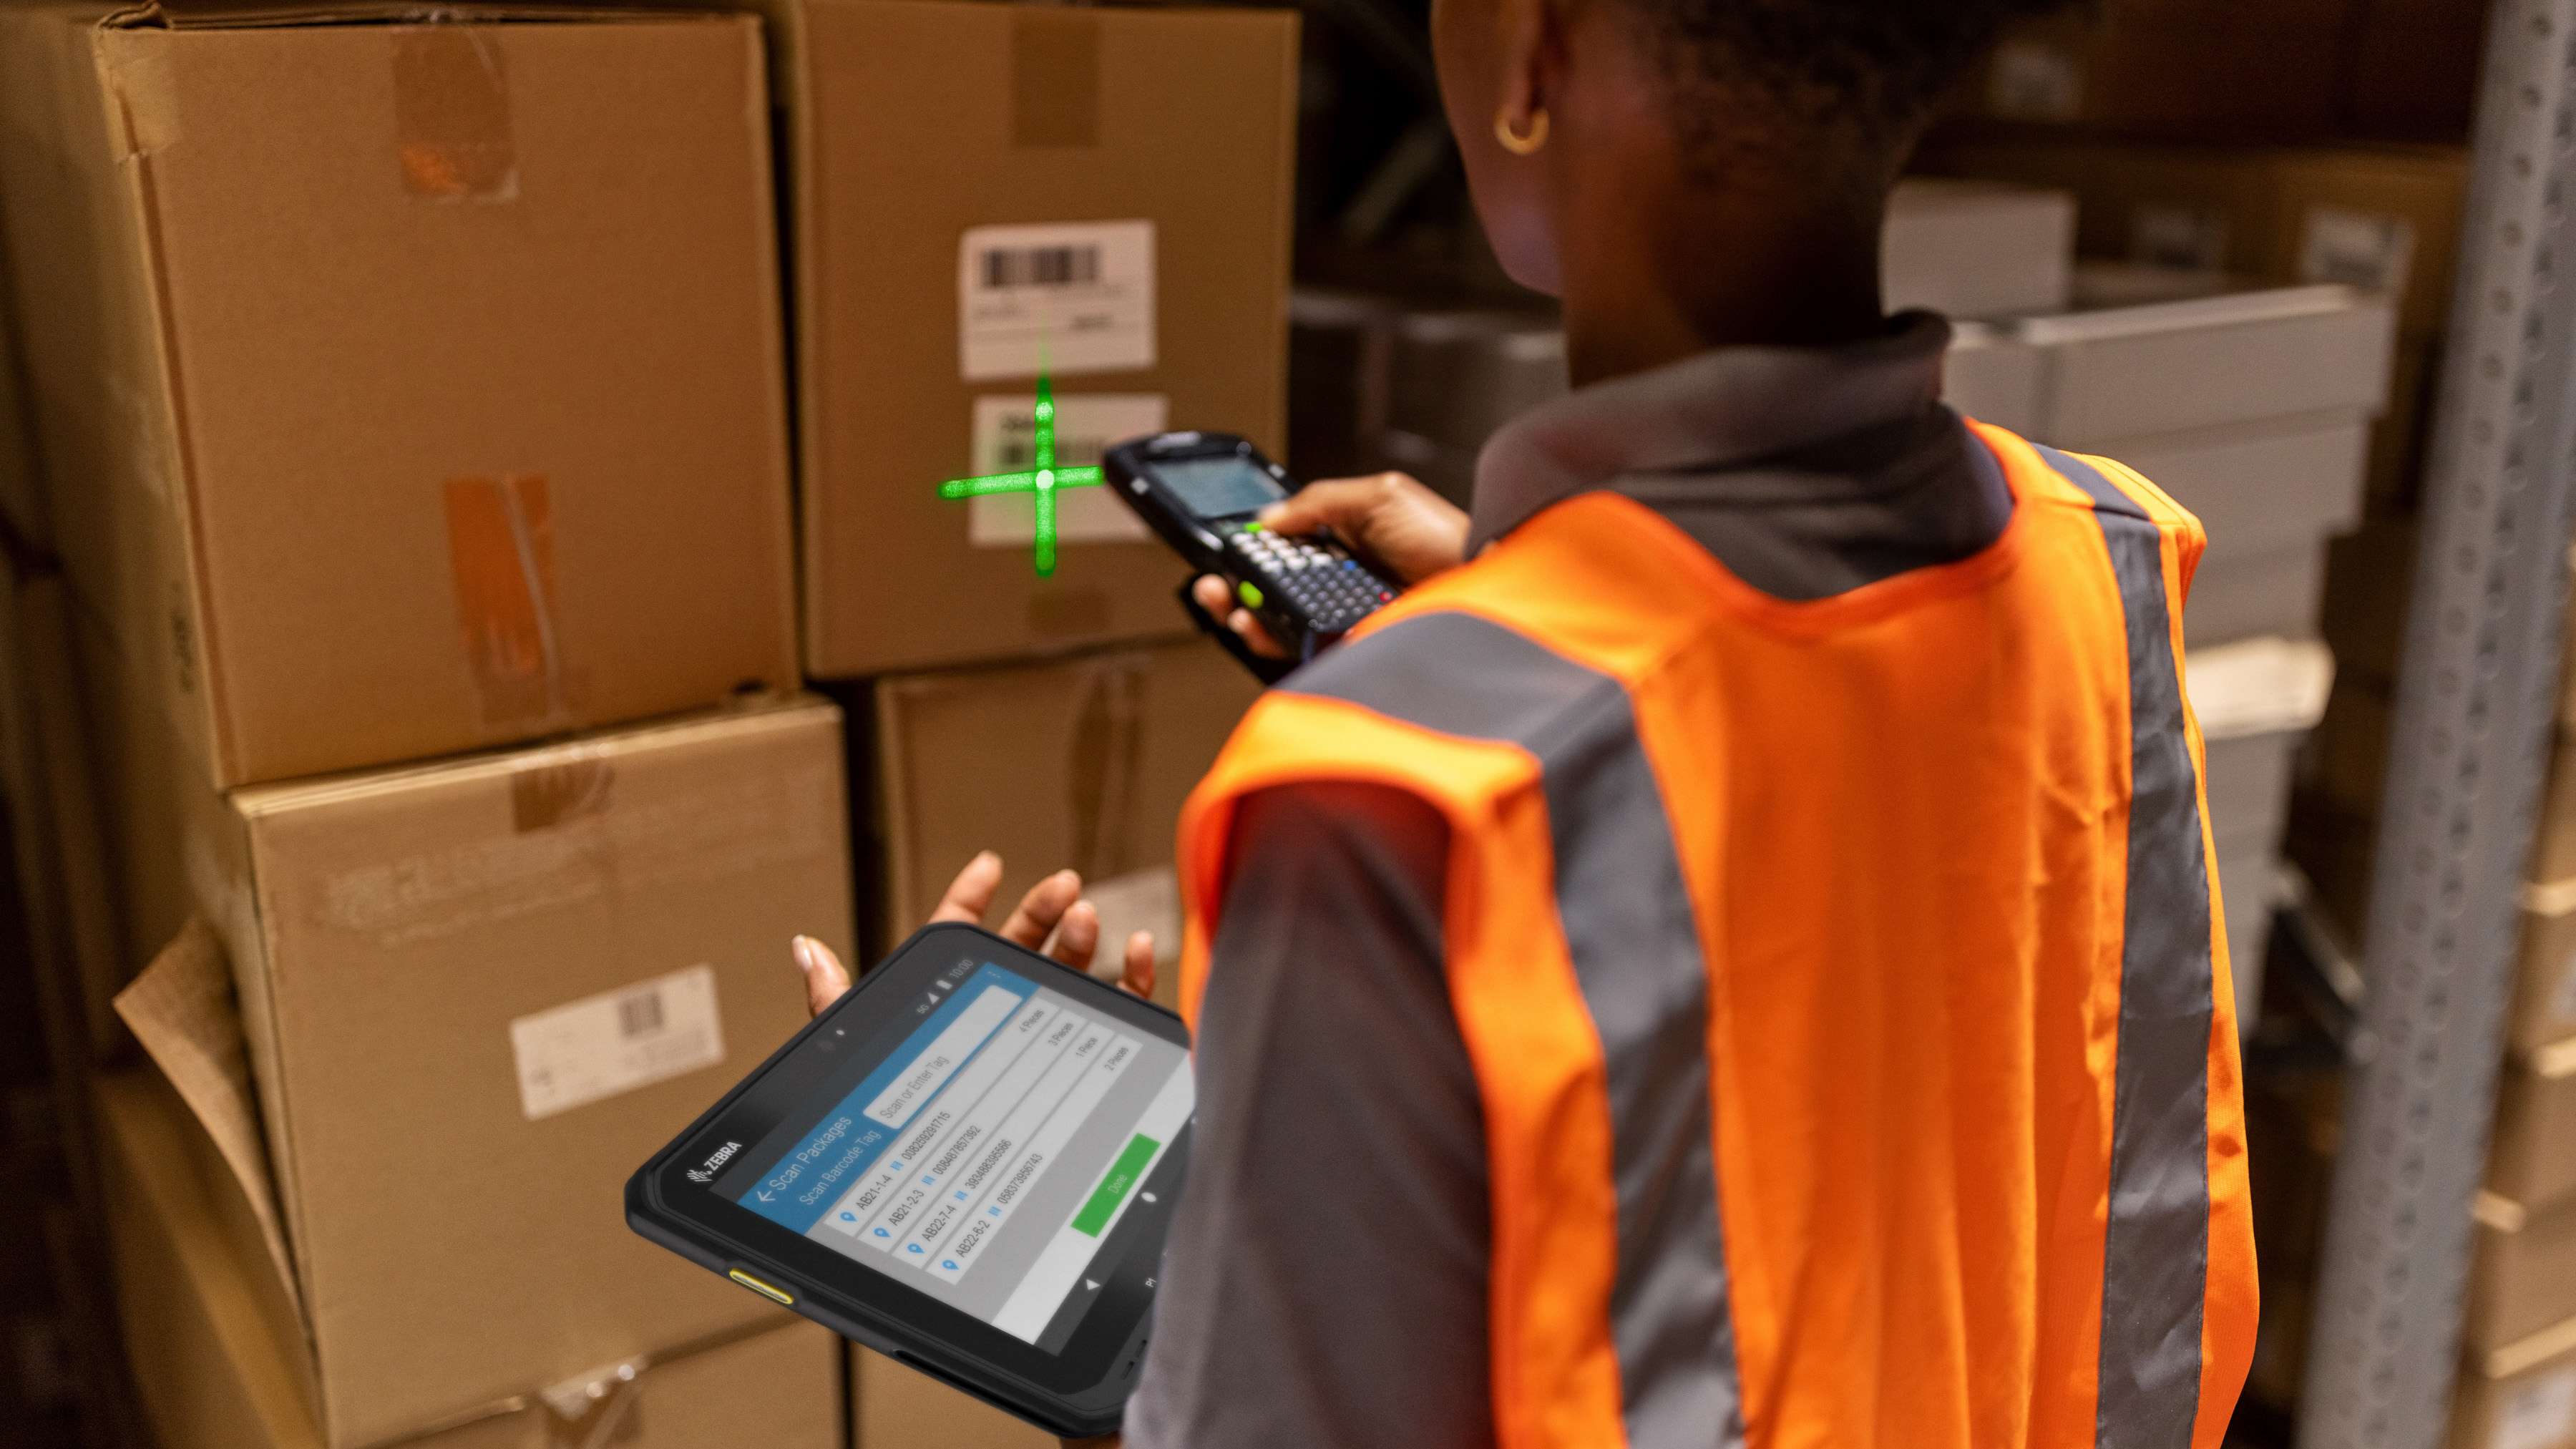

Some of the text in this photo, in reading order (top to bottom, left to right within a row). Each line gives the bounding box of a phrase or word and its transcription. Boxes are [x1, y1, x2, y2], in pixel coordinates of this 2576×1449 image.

[949, 960, 973, 978] 10:00
[917, 1004, 930, 1014] 5G
[1023, 1009, 1045, 1029] Pieces
[1052, 1023, 1073, 1042] Pieces
[1079, 1037, 1098, 1053] Piece
[1108, 1047, 1128, 1066] Pieces
[879, 1056, 950, 1119] Scan or Enter Tag
[769, 1117, 852, 1191] Scan Packages
[901, 1111, 951, 1161] 008259291715
[932, 1125, 981, 1175] 008487857392
[703, 1141, 743, 1171] ZEBRA
[799, 1130, 882, 1205] Scan Barcode Tag
[965, 1139, 1012, 1189] 393488395566
[856, 1174, 893, 1210] AB21-1-4
[997, 1153, 1043, 1205] 058373956743
[1108, 1174, 1128, 1194] Done
[888, 1189, 924, 1226] AB21-2-3
[921, 1204, 957, 1242] AB22-7-4
[955, 1219, 990, 1258] AB22-6-2
[1145, 1277, 1156, 1287] P1
